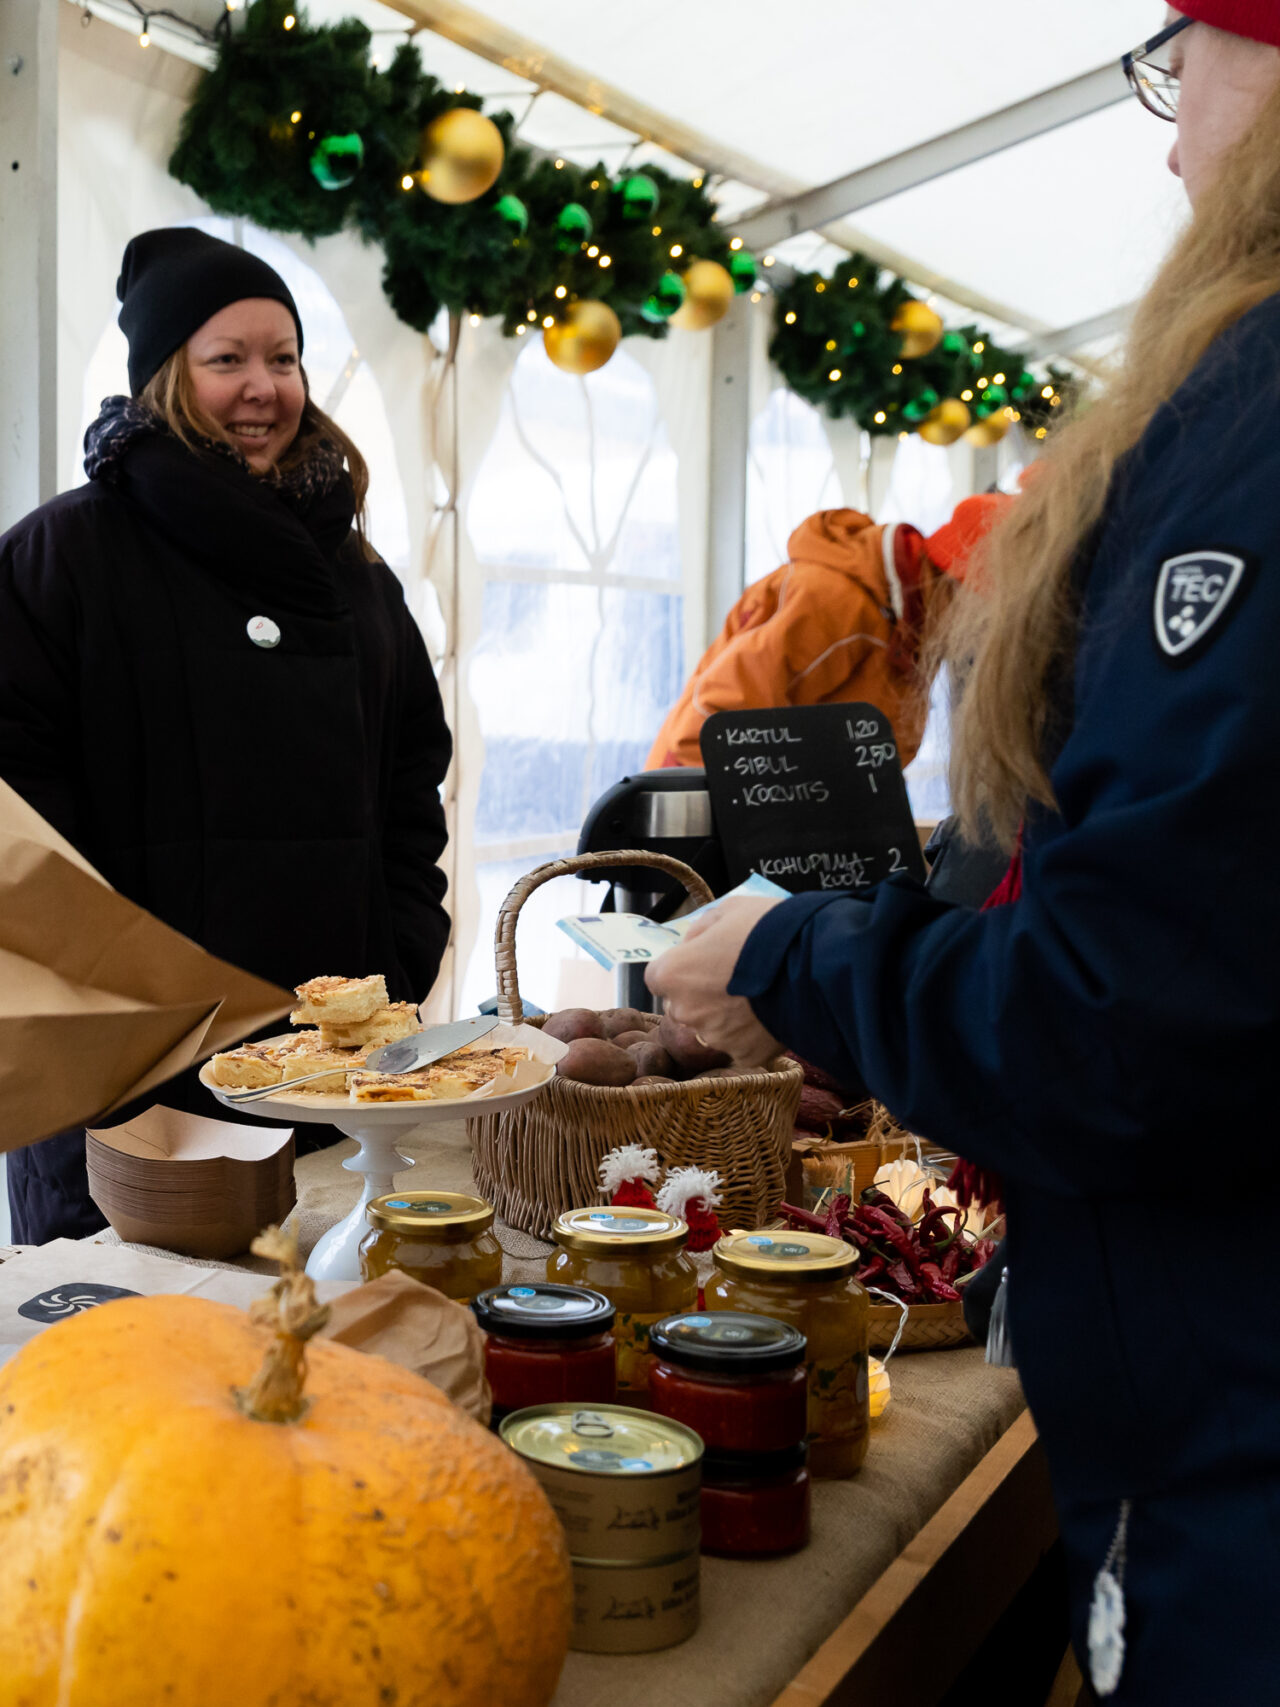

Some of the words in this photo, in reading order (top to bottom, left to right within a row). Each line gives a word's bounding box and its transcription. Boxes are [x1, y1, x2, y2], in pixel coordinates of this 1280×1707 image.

[1170, 574, 1225, 603] TEC
[726, 727, 802, 746] KARTUL
[733, 755, 799, 775] SIBUL
[887, 847, 908, 872] 2
[618, 947, 652, 959] 20
